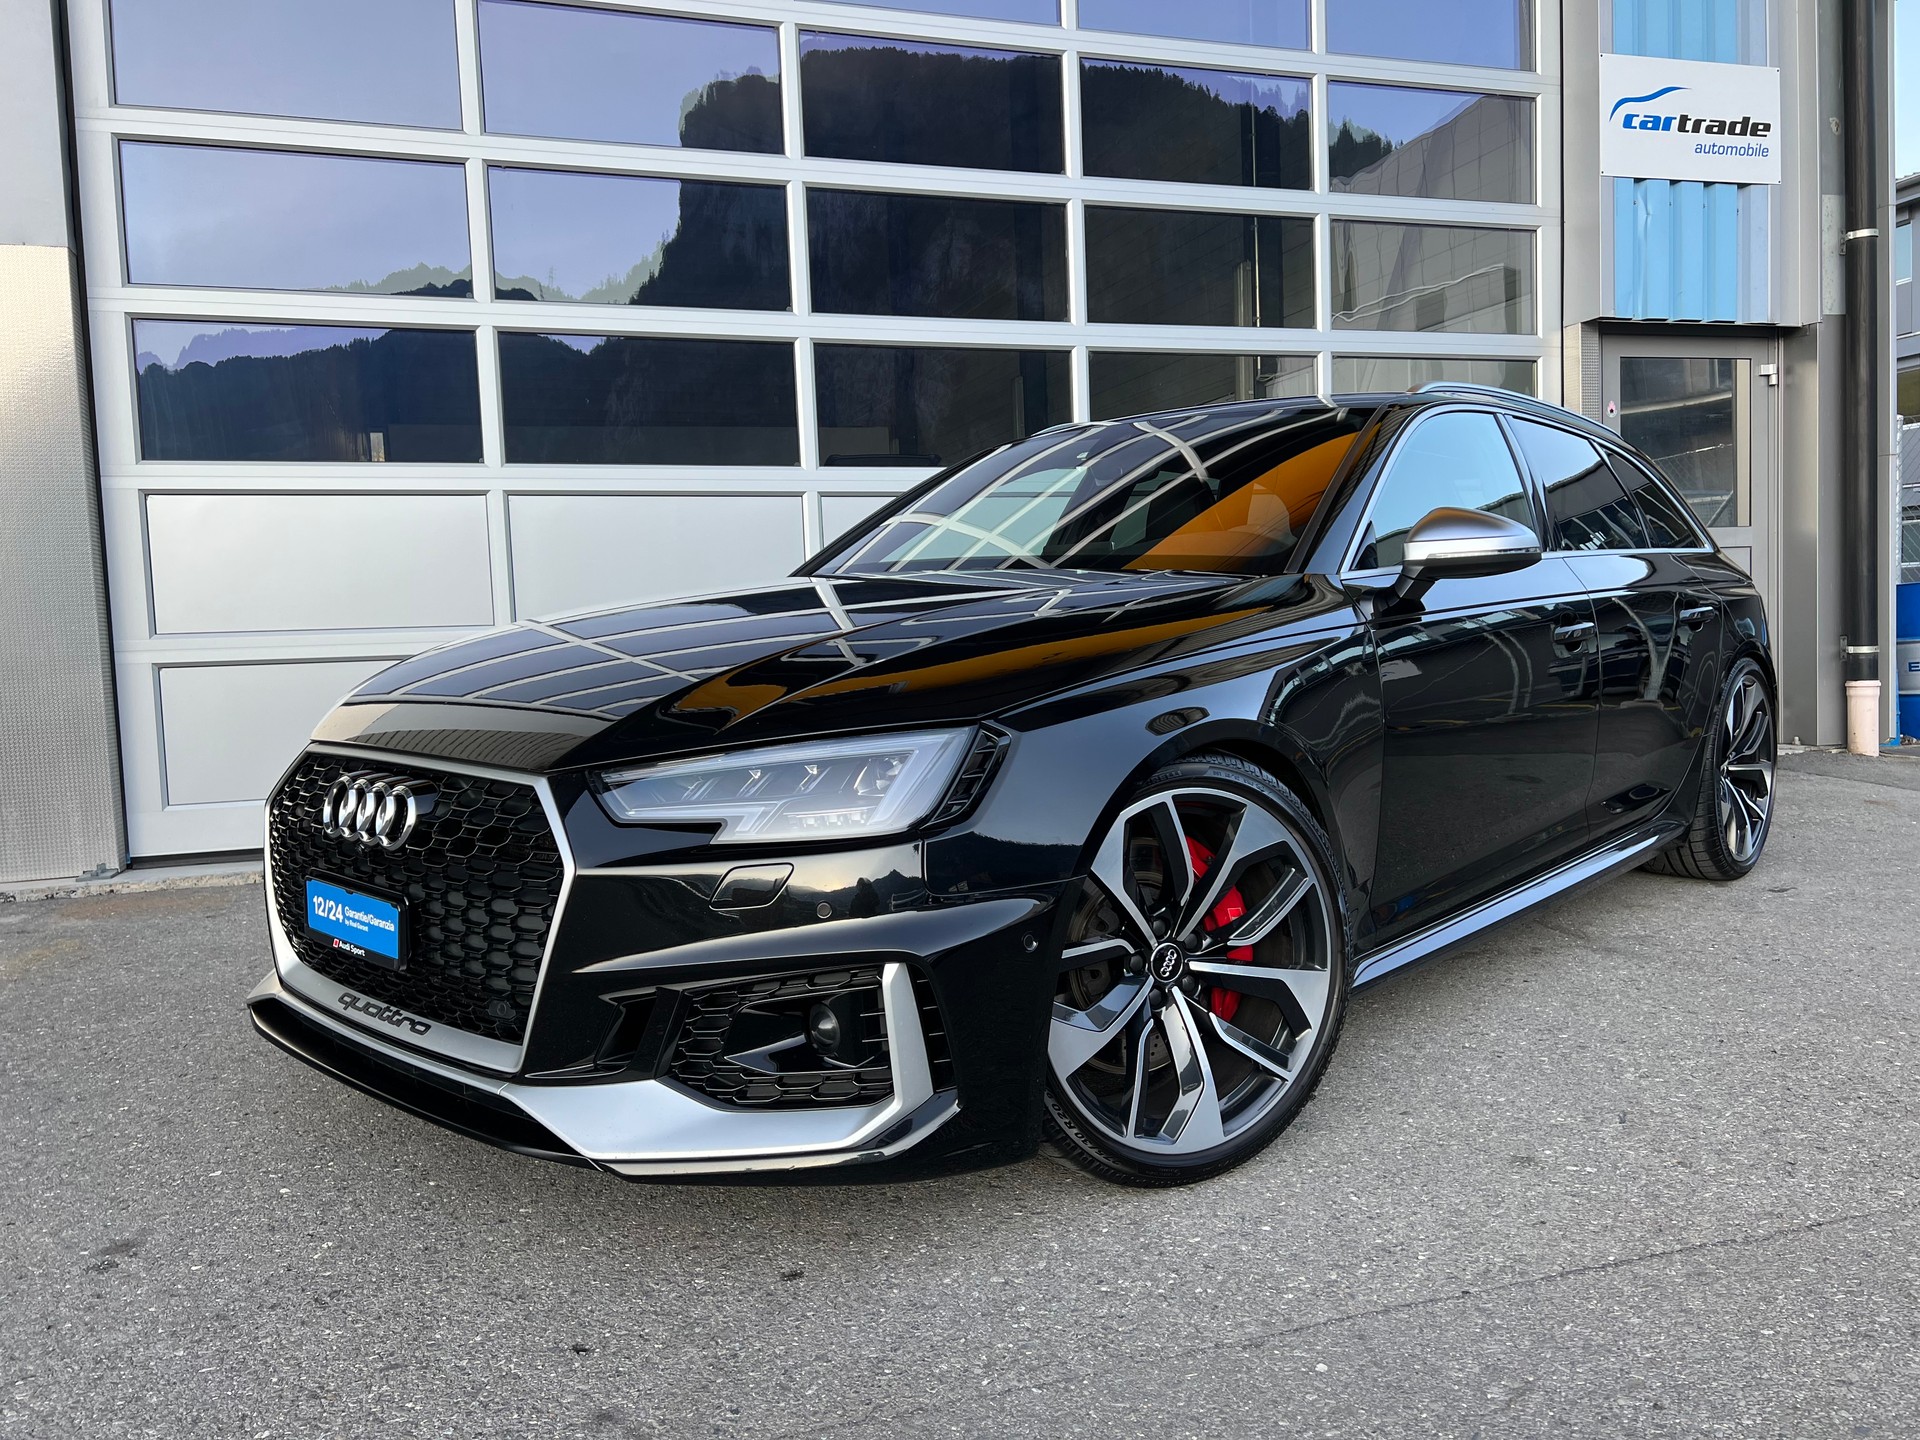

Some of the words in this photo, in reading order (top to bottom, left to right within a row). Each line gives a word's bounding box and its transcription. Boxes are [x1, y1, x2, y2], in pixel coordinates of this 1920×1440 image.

[1622, 113, 1772, 138] cartrade
[1694, 142, 1769, 158] automobile
[313, 895, 343, 923] 12/24
[344, 906, 395, 932] Garantie/Garanzia
[339, 940, 350, 952] Audi
[350, 944, 365, 957] Sport
[337, 992, 432, 1036] quattro
